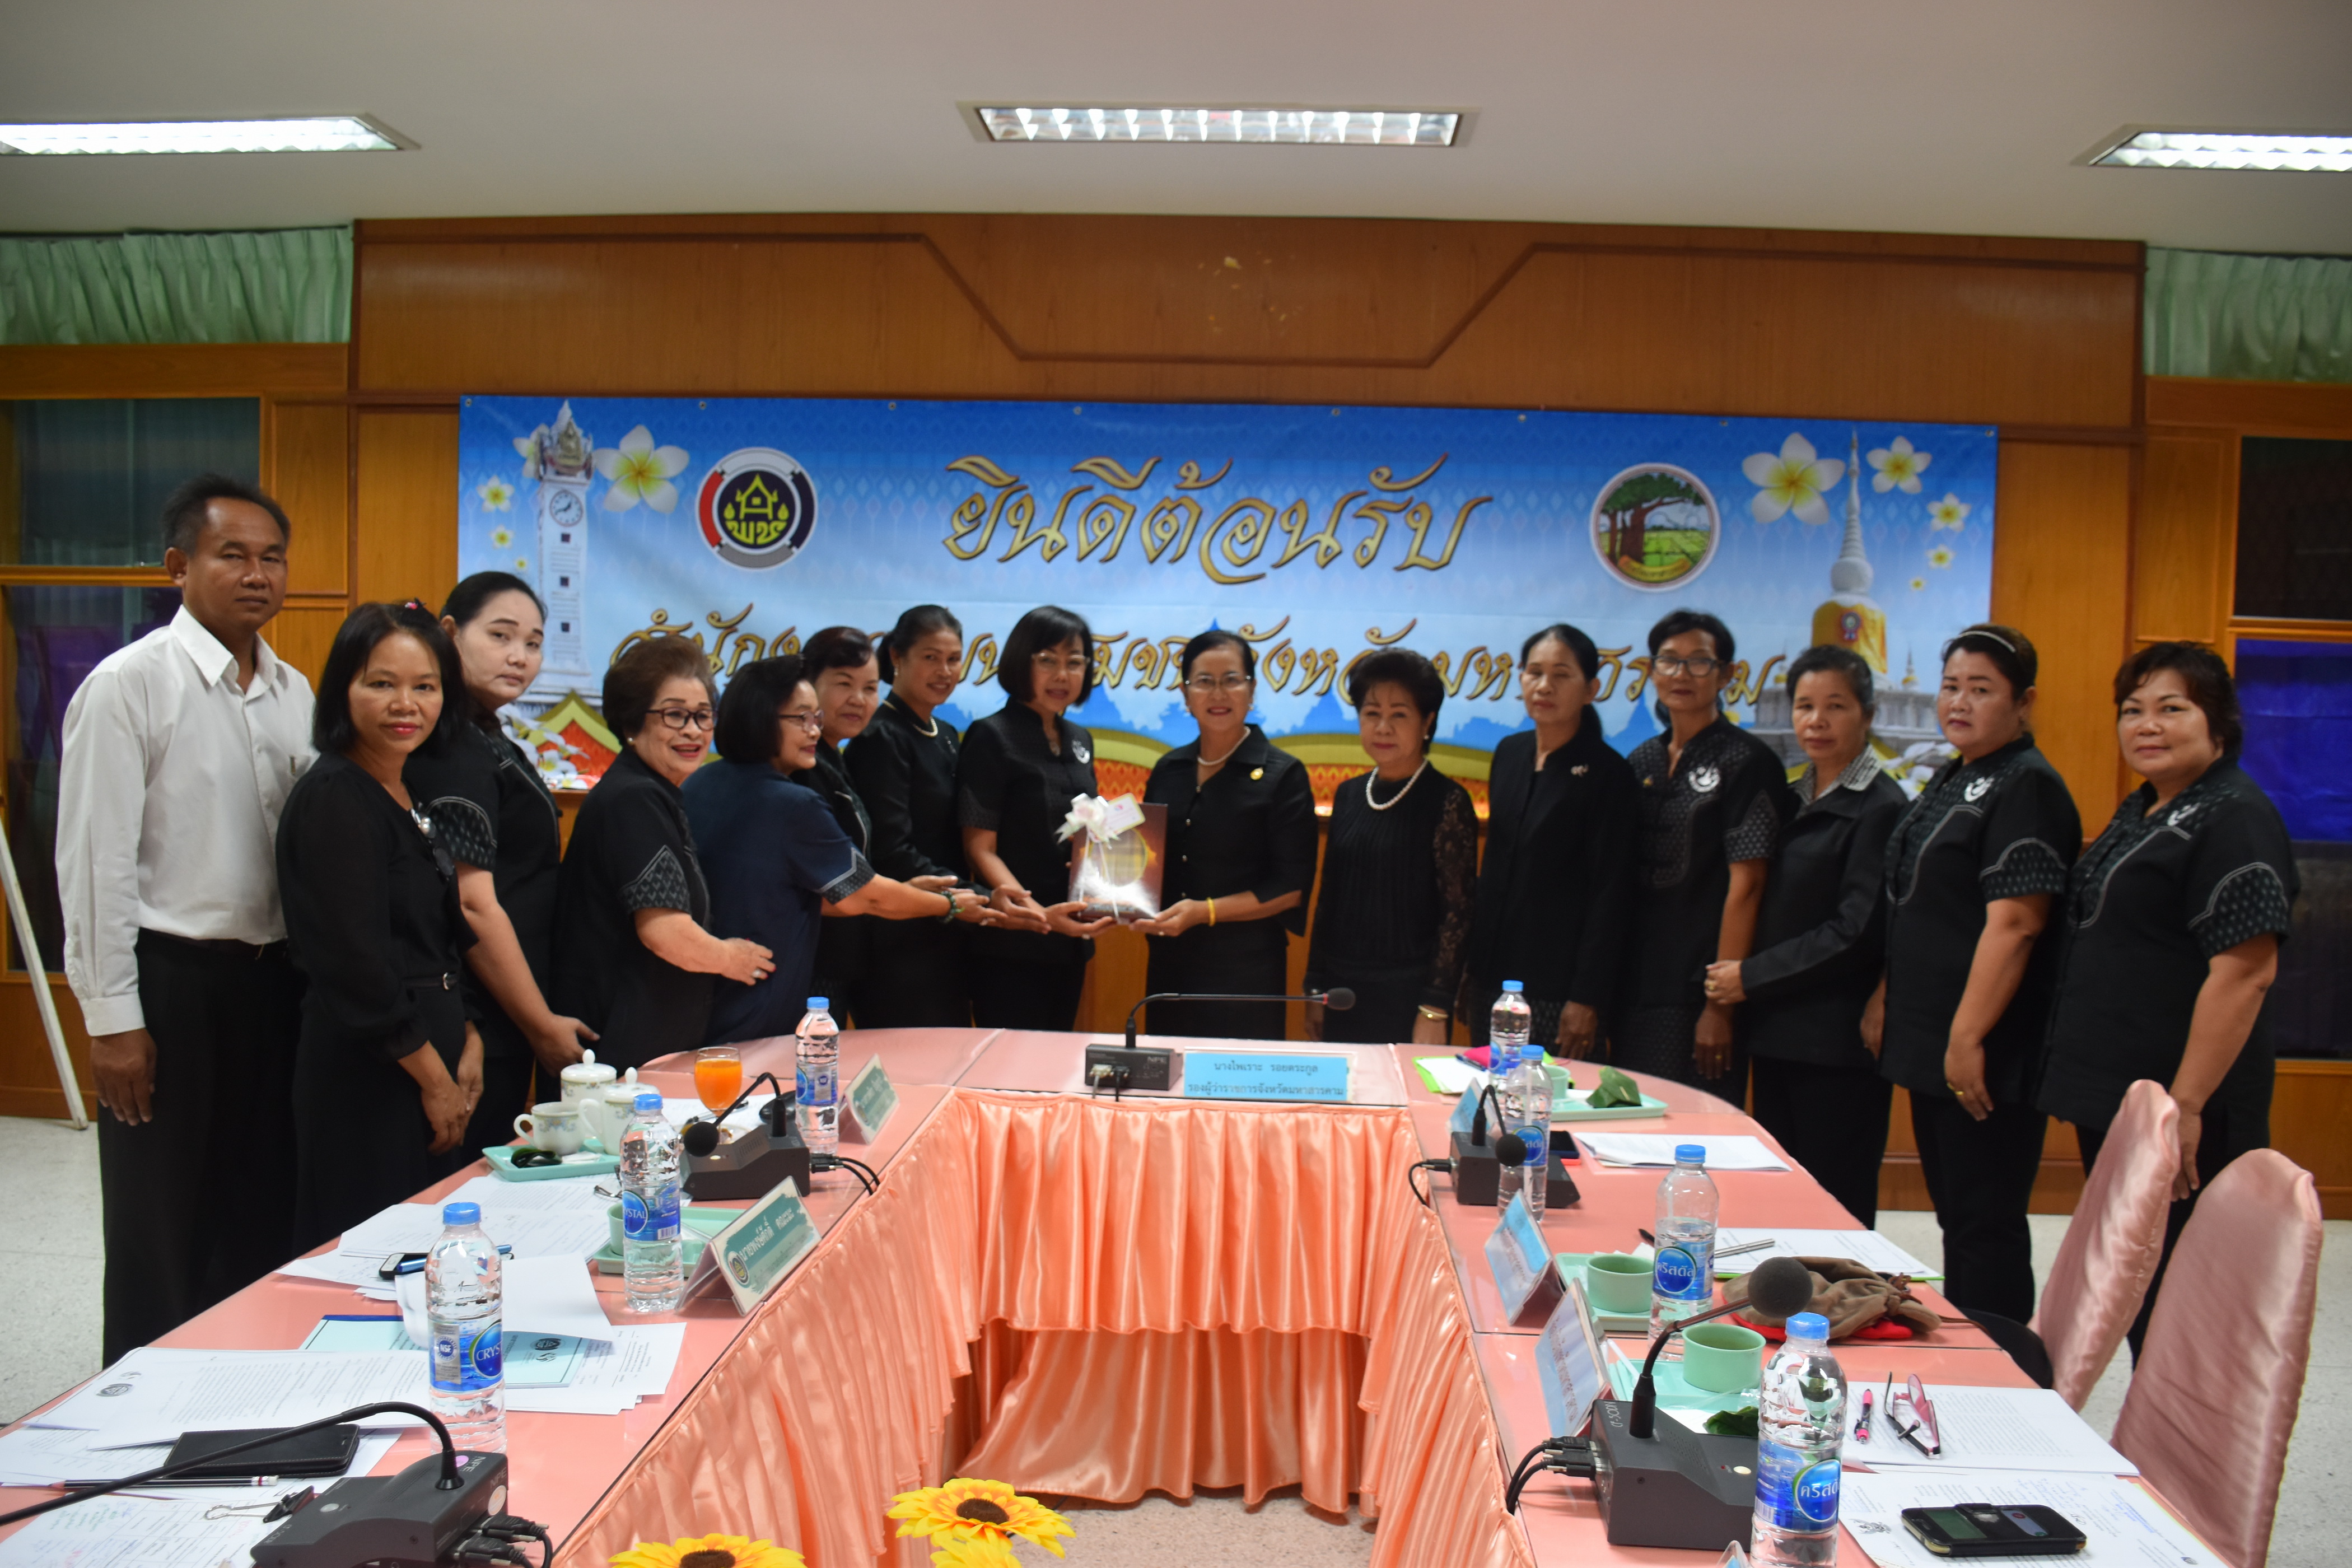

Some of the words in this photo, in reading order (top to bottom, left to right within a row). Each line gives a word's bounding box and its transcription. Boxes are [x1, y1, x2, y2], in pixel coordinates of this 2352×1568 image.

[943, 452, 1493, 584] ยินดีต้อนรับ
[477, 1342, 501, 1361] CRYS
[462, 1456, 486, 1472] NPE
